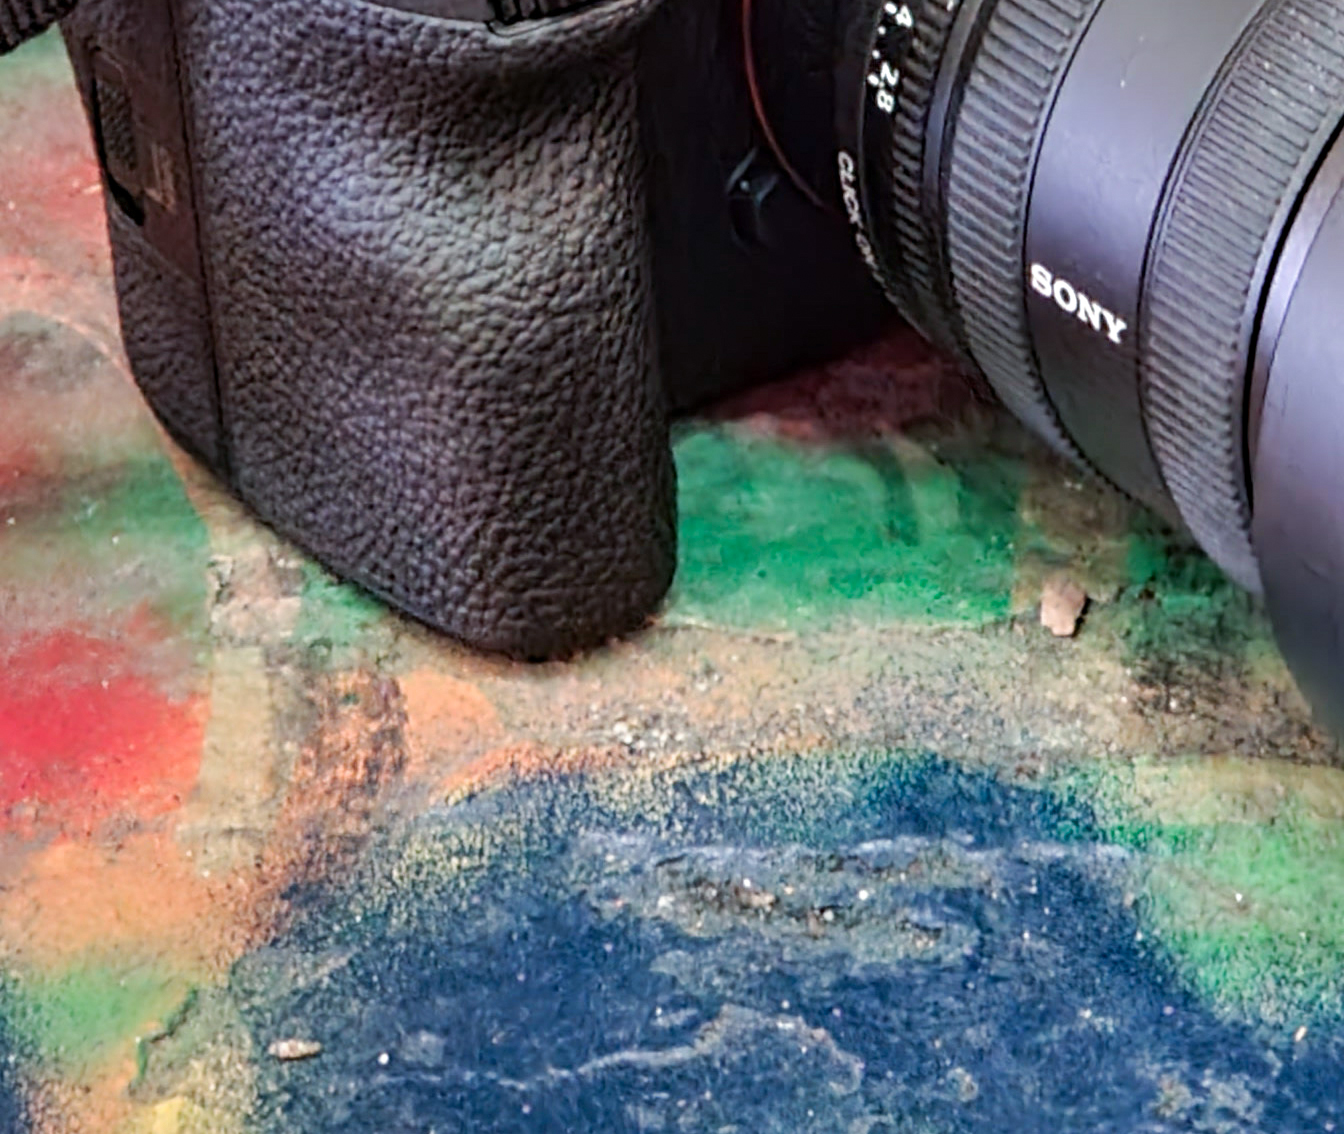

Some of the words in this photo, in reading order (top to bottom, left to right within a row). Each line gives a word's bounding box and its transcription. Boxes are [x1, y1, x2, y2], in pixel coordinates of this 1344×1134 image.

[877, 61, 900, 115] 2.8
[894, 5, 914, 29] 4
[1030, 262, 1128, 344] SONY
